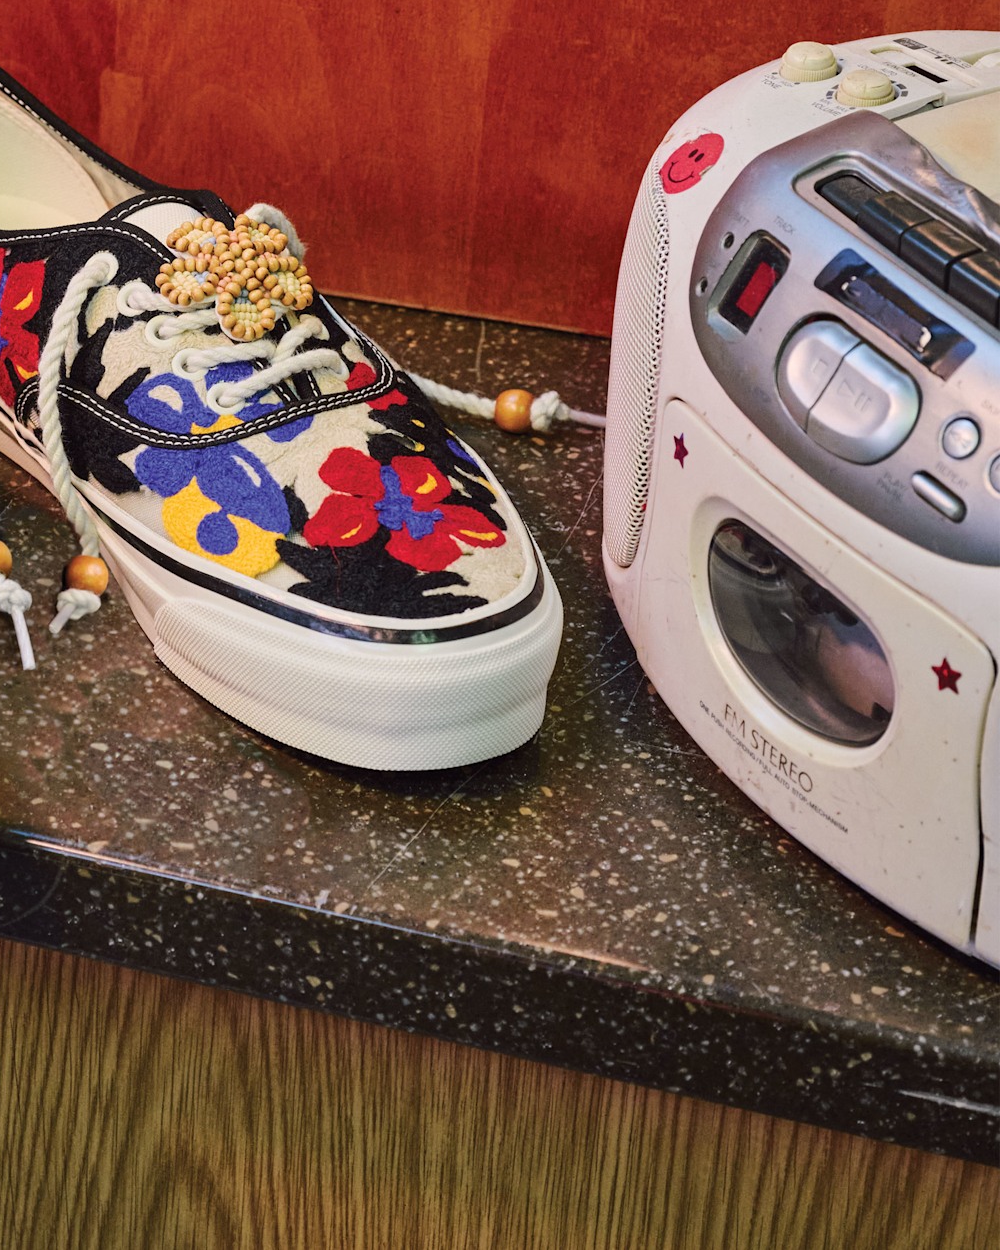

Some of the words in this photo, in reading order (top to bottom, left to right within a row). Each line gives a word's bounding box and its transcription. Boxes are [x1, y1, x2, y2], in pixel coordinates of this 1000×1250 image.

[761, 78, 783, 90] TONE
[811, 101, 842, 117] VOLUME
[724, 703, 746, 739] FM
[750, 729, 814, 793] STEREO
[774, 774, 791, 790] AUTO
